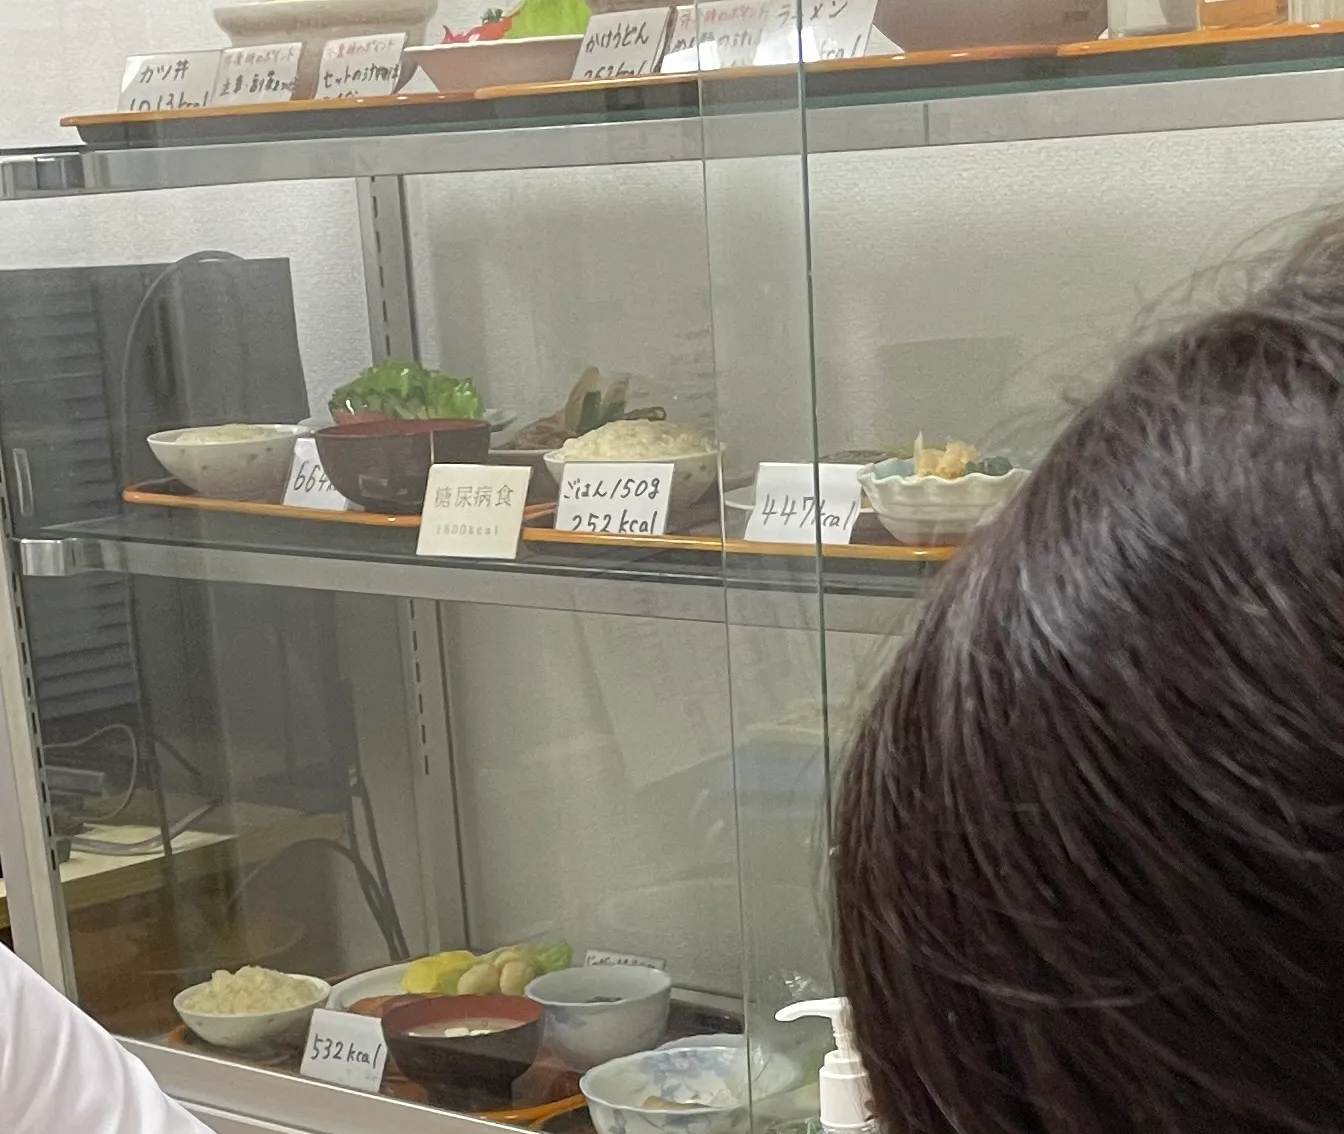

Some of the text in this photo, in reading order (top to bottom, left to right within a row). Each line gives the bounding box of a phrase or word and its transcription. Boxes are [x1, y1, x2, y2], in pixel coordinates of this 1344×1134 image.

[585, 22, 650, 53] かけうどん
[435, 484, 514, 509] 糖尿病食
[762, 493, 858, 532] 447kcal
[310, 1037, 384, 1068] 532kcal
